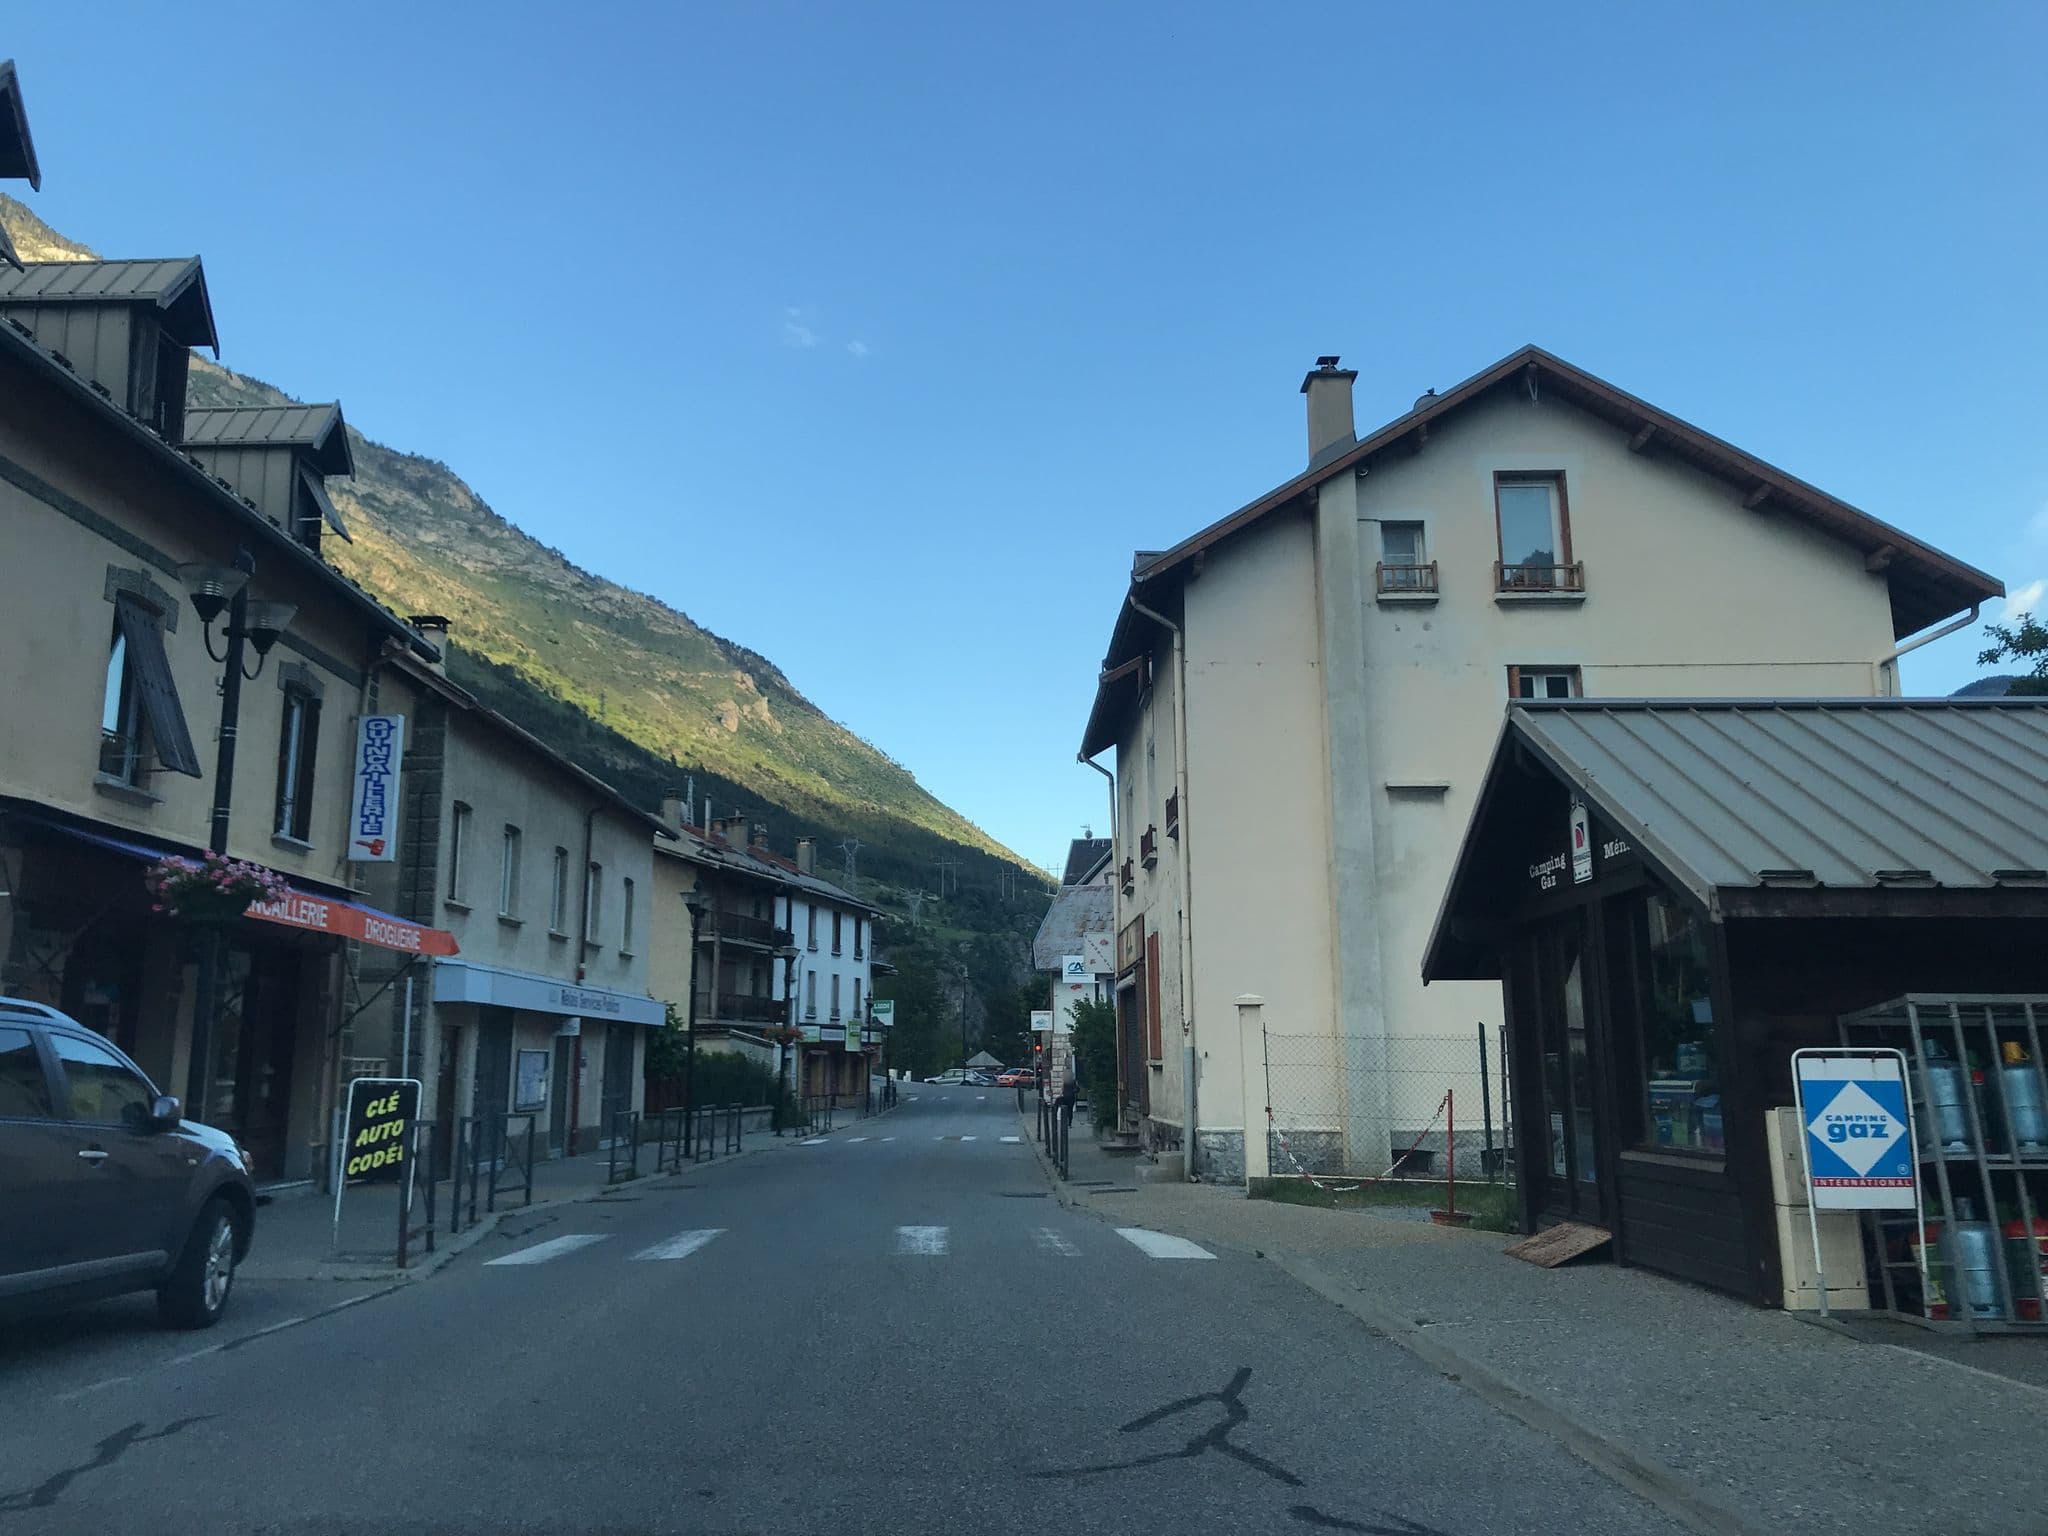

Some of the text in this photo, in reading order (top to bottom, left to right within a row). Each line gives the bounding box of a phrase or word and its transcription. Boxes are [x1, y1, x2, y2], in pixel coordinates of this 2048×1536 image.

[360, 718, 395, 835] QUINCAILLERIE
[1529, 853, 1567, 878] Camping
[1541, 875, 1557, 890] Gaz
[364, 919, 420, 949] DROGUERIE
[366, 1090, 400, 1118] CLÉ
[1825, 1114, 1888, 1122] CAMPING
[355, 1119, 404, 1147] AUTO
[1827, 1122, 1889, 1144] gaz
[1814, 1178, 1911, 1187] INTERNATIONAL
